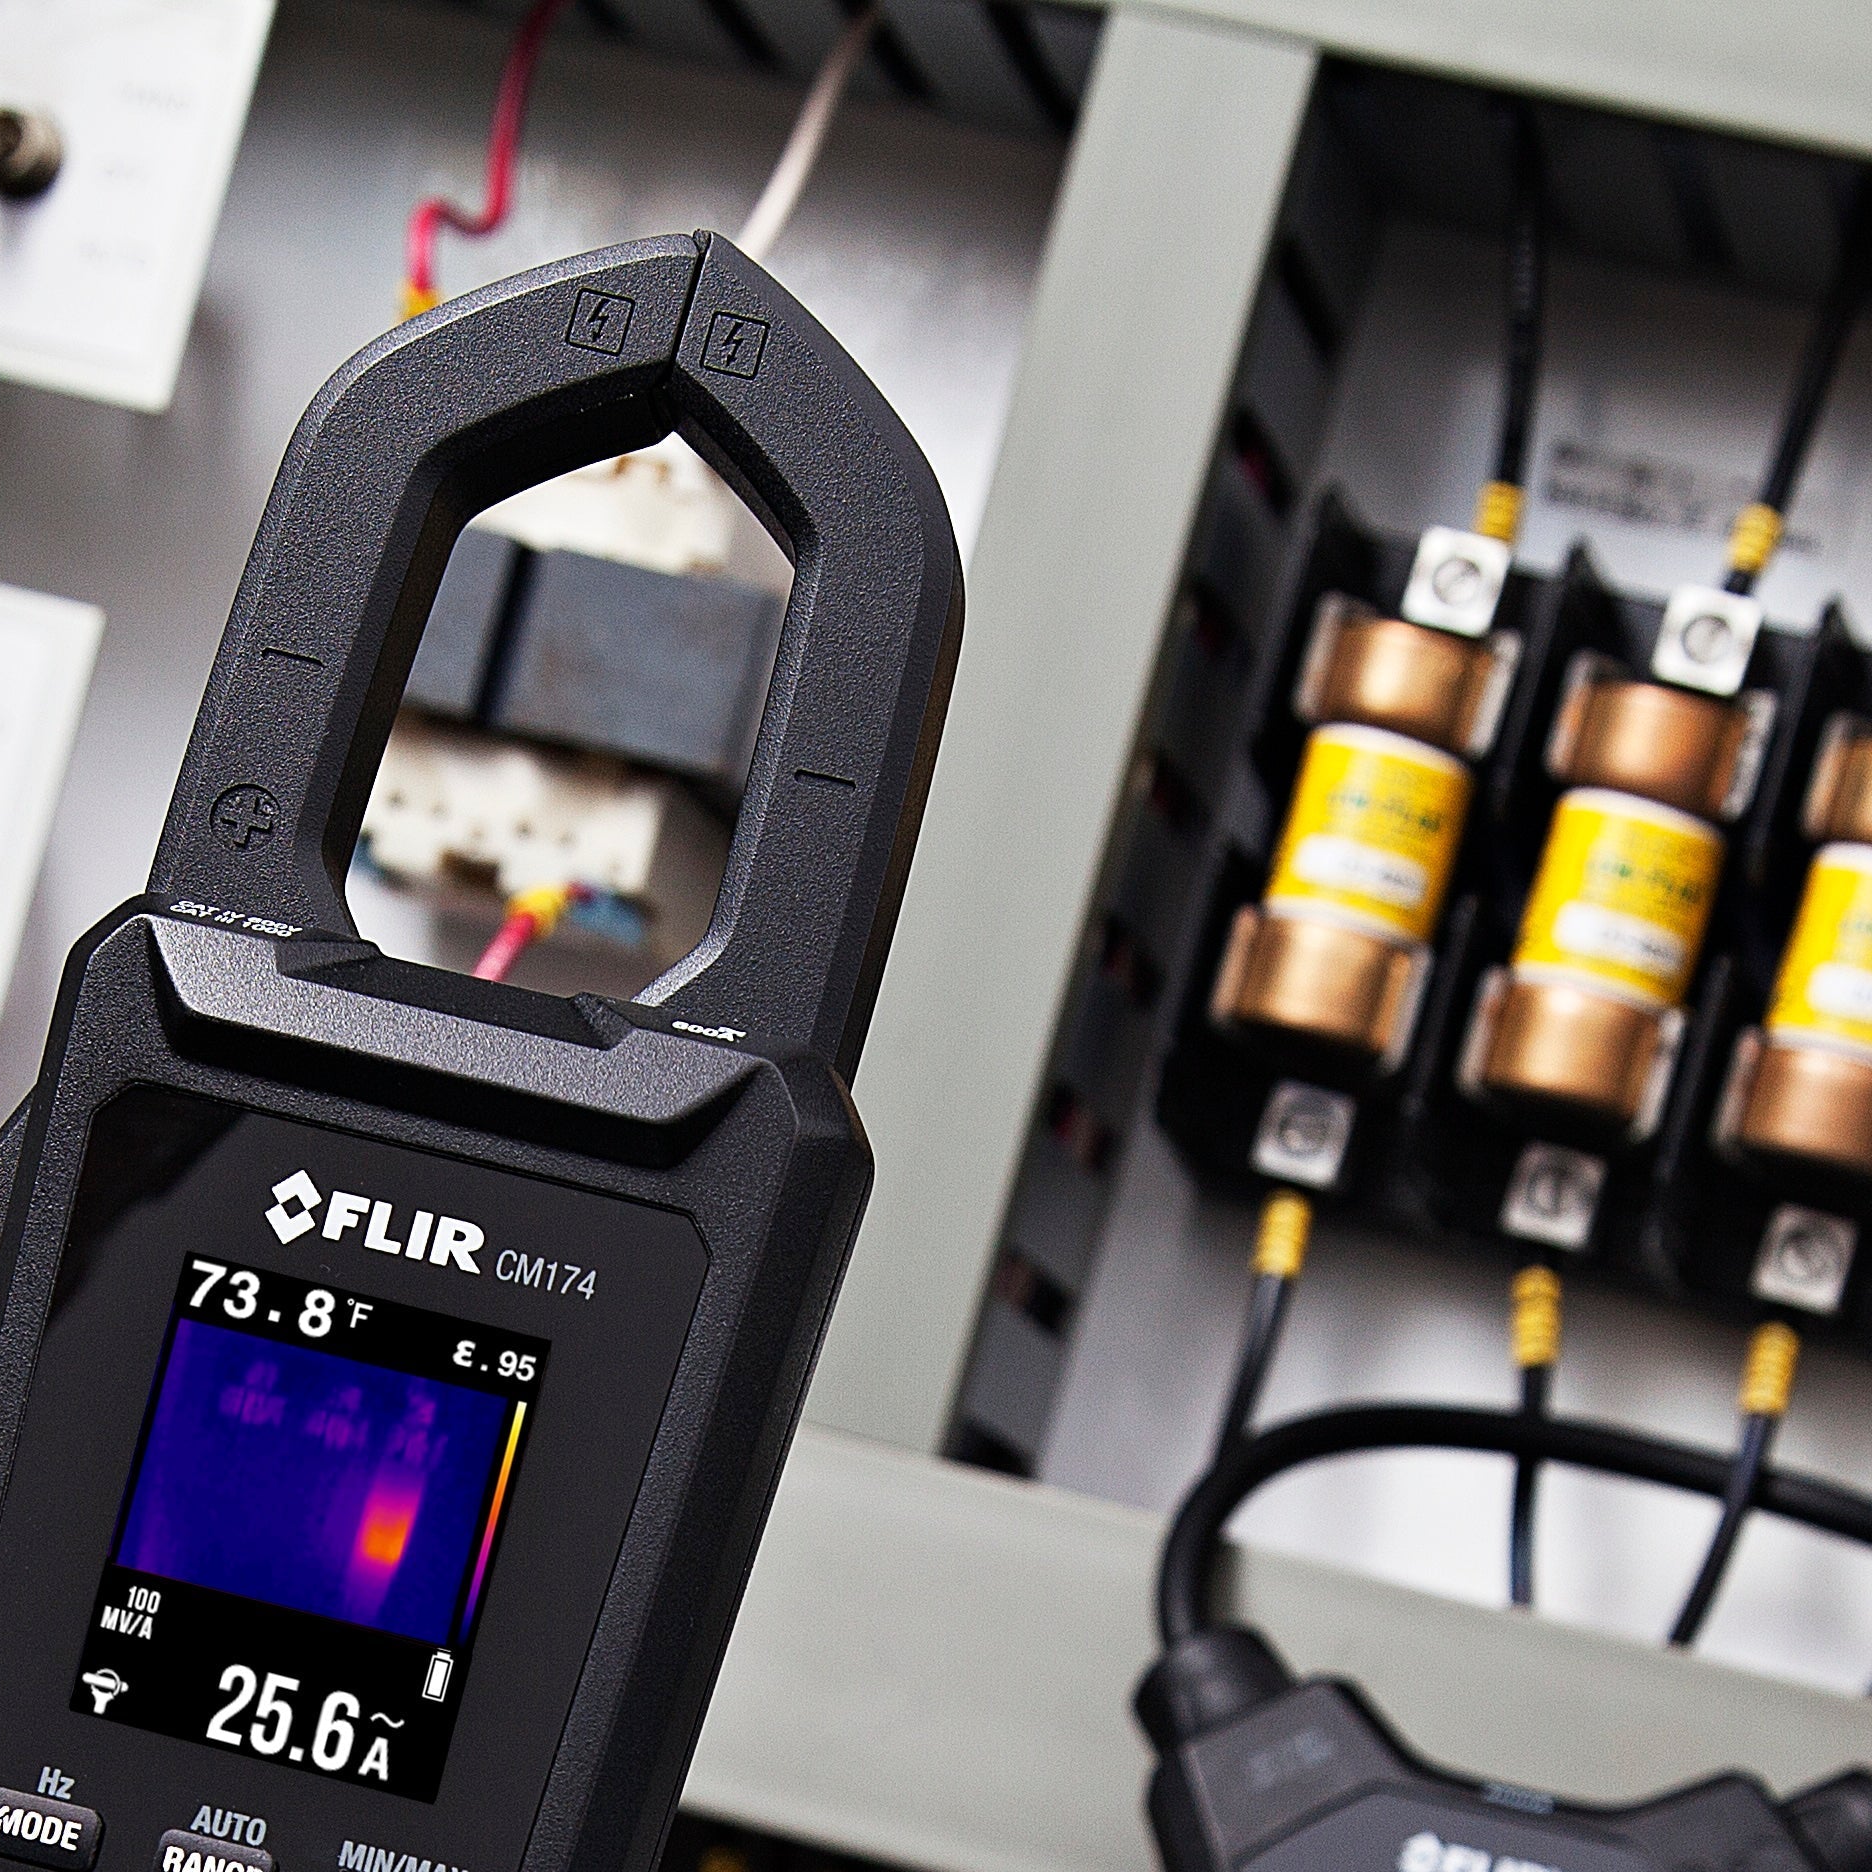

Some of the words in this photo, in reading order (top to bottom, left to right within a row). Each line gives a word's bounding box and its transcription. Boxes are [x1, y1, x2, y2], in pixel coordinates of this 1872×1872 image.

[169, 904, 212, 918] CAT
[178, 900, 220, 912] CAT
[321, 1190, 486, 1275] FLIR
[494, 1249, 598, 1301] CM174
[188, 1259, 336, 1338] 73.8
[126, 1585, 162, 1615] 100
[100, 1605, 154, 1640] MV/A
[206, 1663, 361, 1772] 25.6
[357, 1736, 390, 1782] A
[37, 1766, 75, 1800] Hz
[190, 1805, 267, 1846] AUTO
